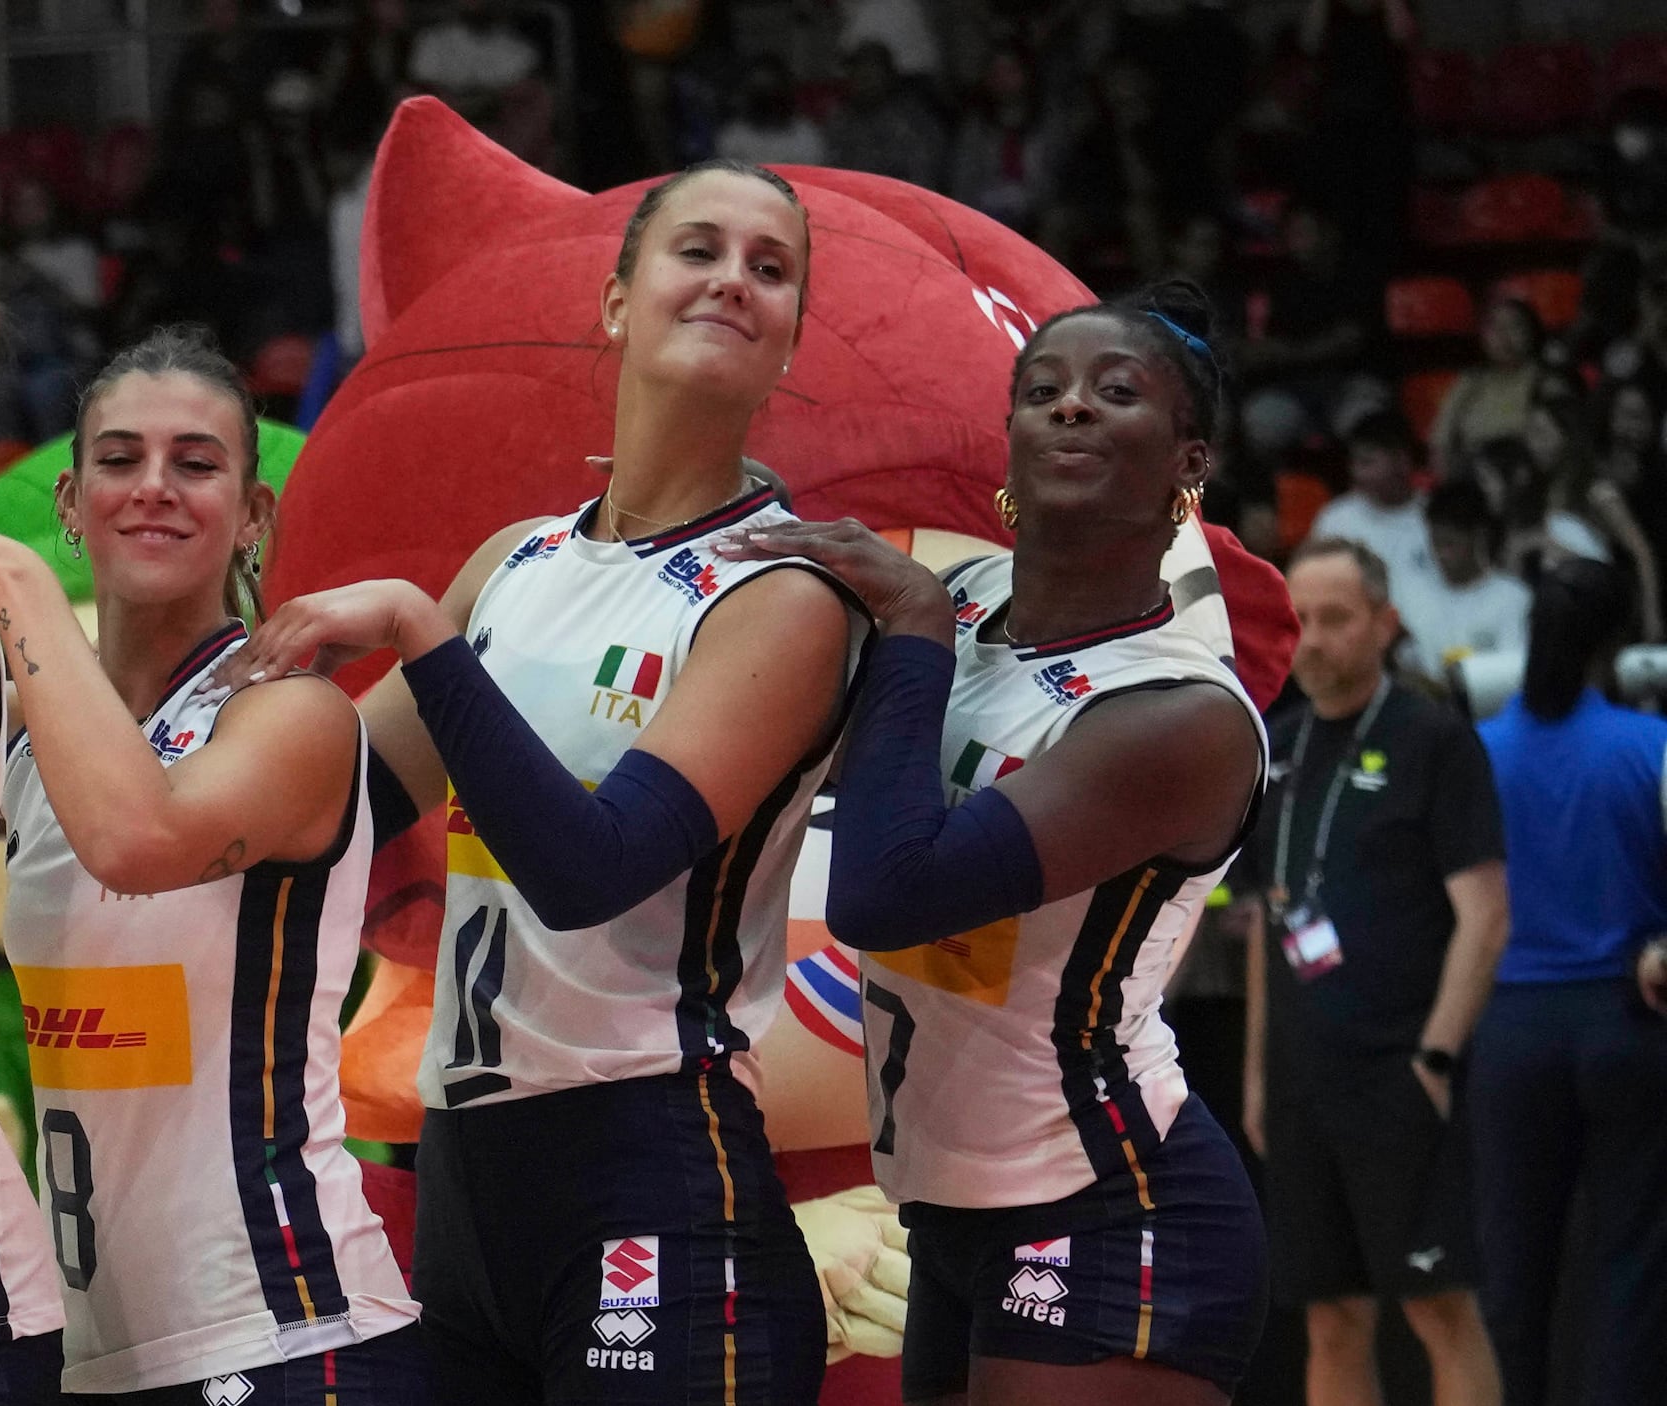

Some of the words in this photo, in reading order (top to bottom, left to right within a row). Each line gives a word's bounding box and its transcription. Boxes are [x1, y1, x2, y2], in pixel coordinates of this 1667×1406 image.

[590, 689, 641, 728] ITA
[42, 1108, 97, 1292] 8
[601, 1296, 659, 1309] SUZUKI
